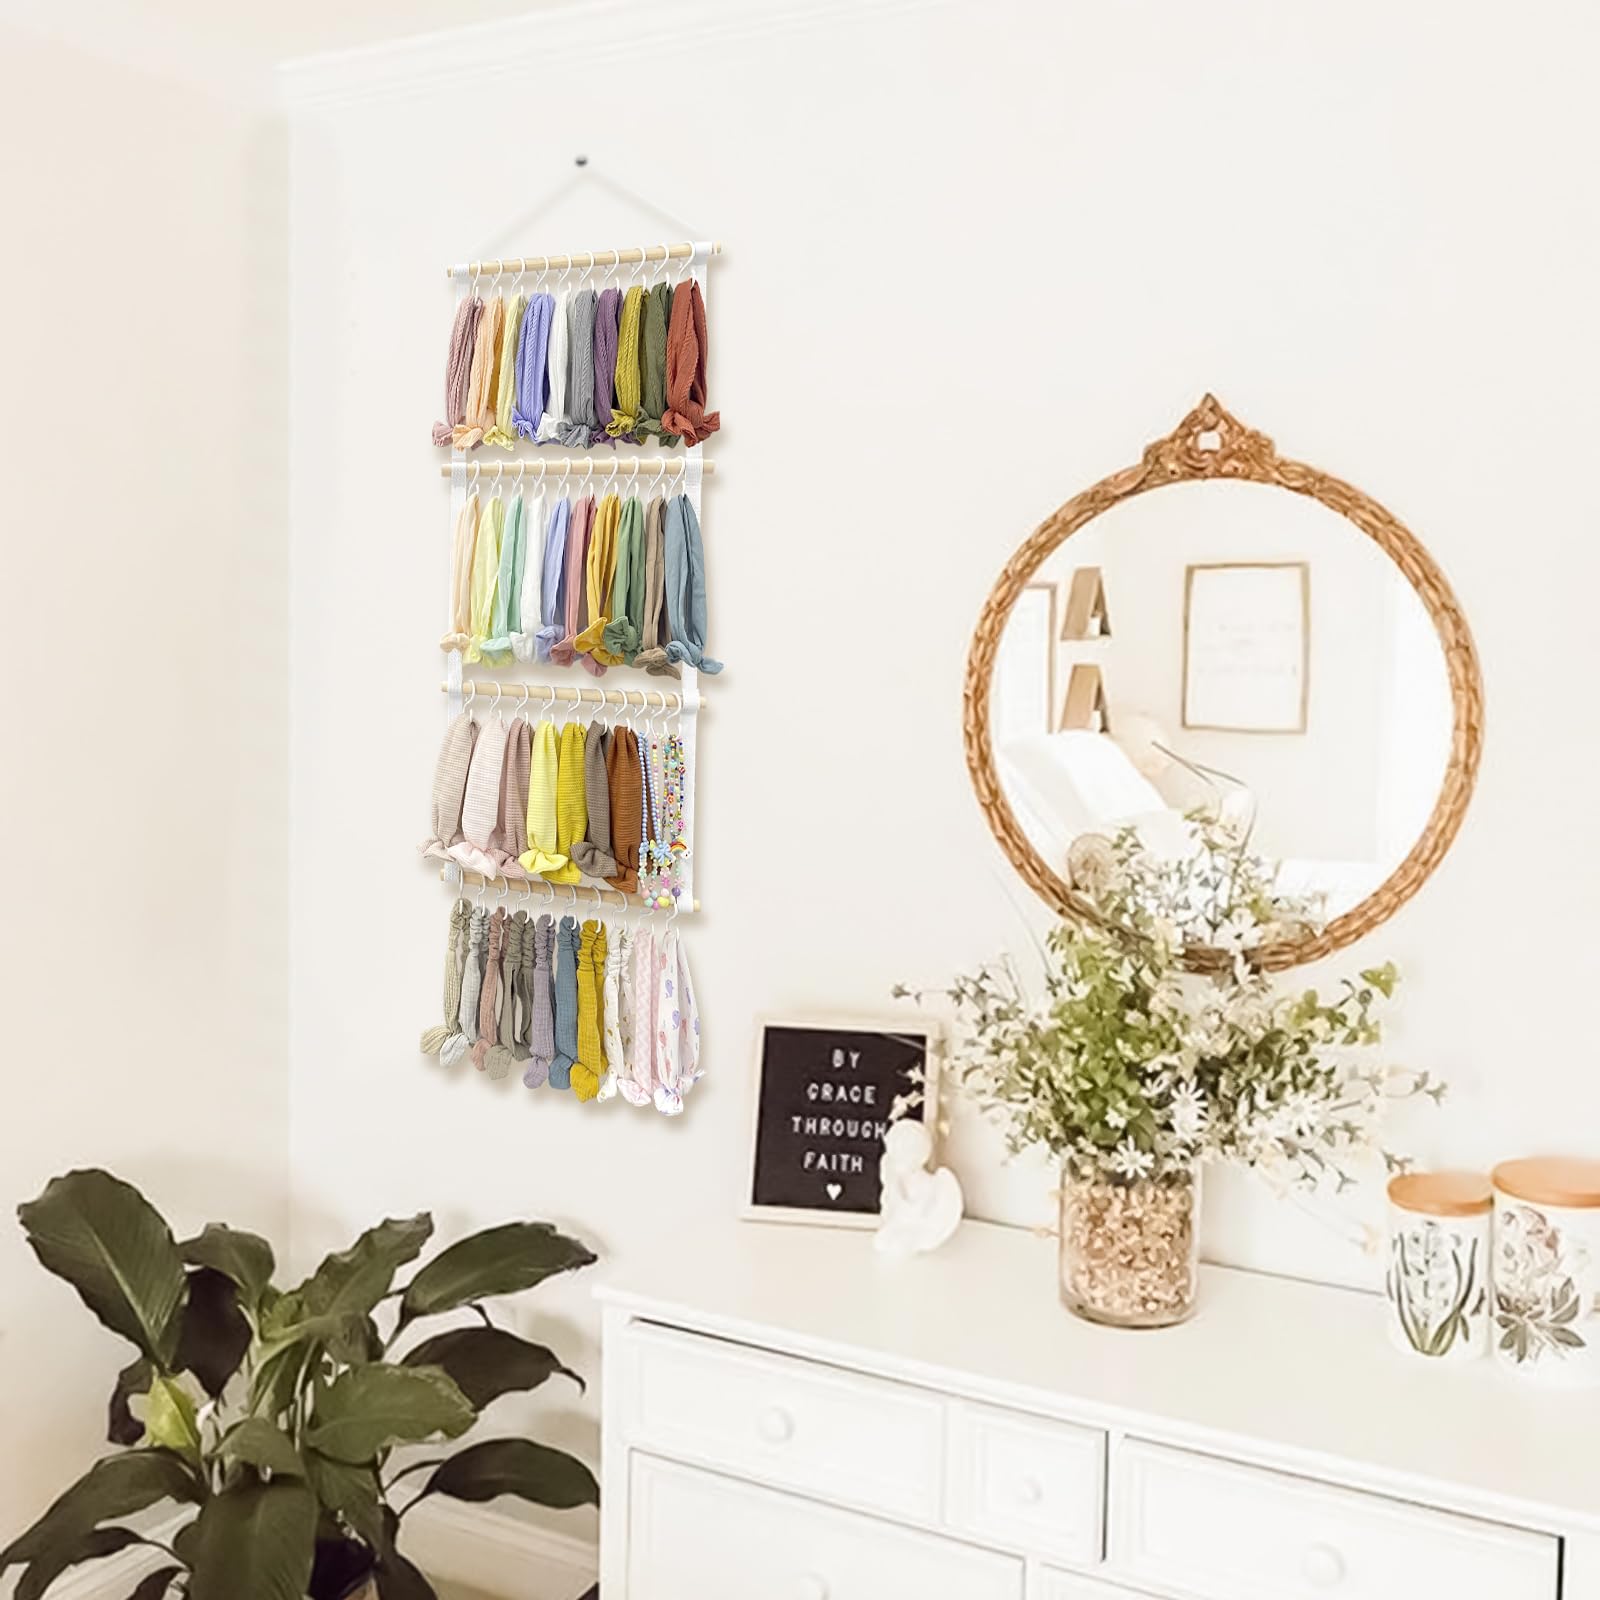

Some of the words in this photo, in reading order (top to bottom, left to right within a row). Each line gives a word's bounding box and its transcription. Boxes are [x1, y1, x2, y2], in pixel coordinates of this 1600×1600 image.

[832, 1048, 860, 1068] BY
[806, 1082, 876, 1104] GRACE
[791, 1115, 886, 1140] THROUGH
[803, 1151, 863, 1173] FAITH
